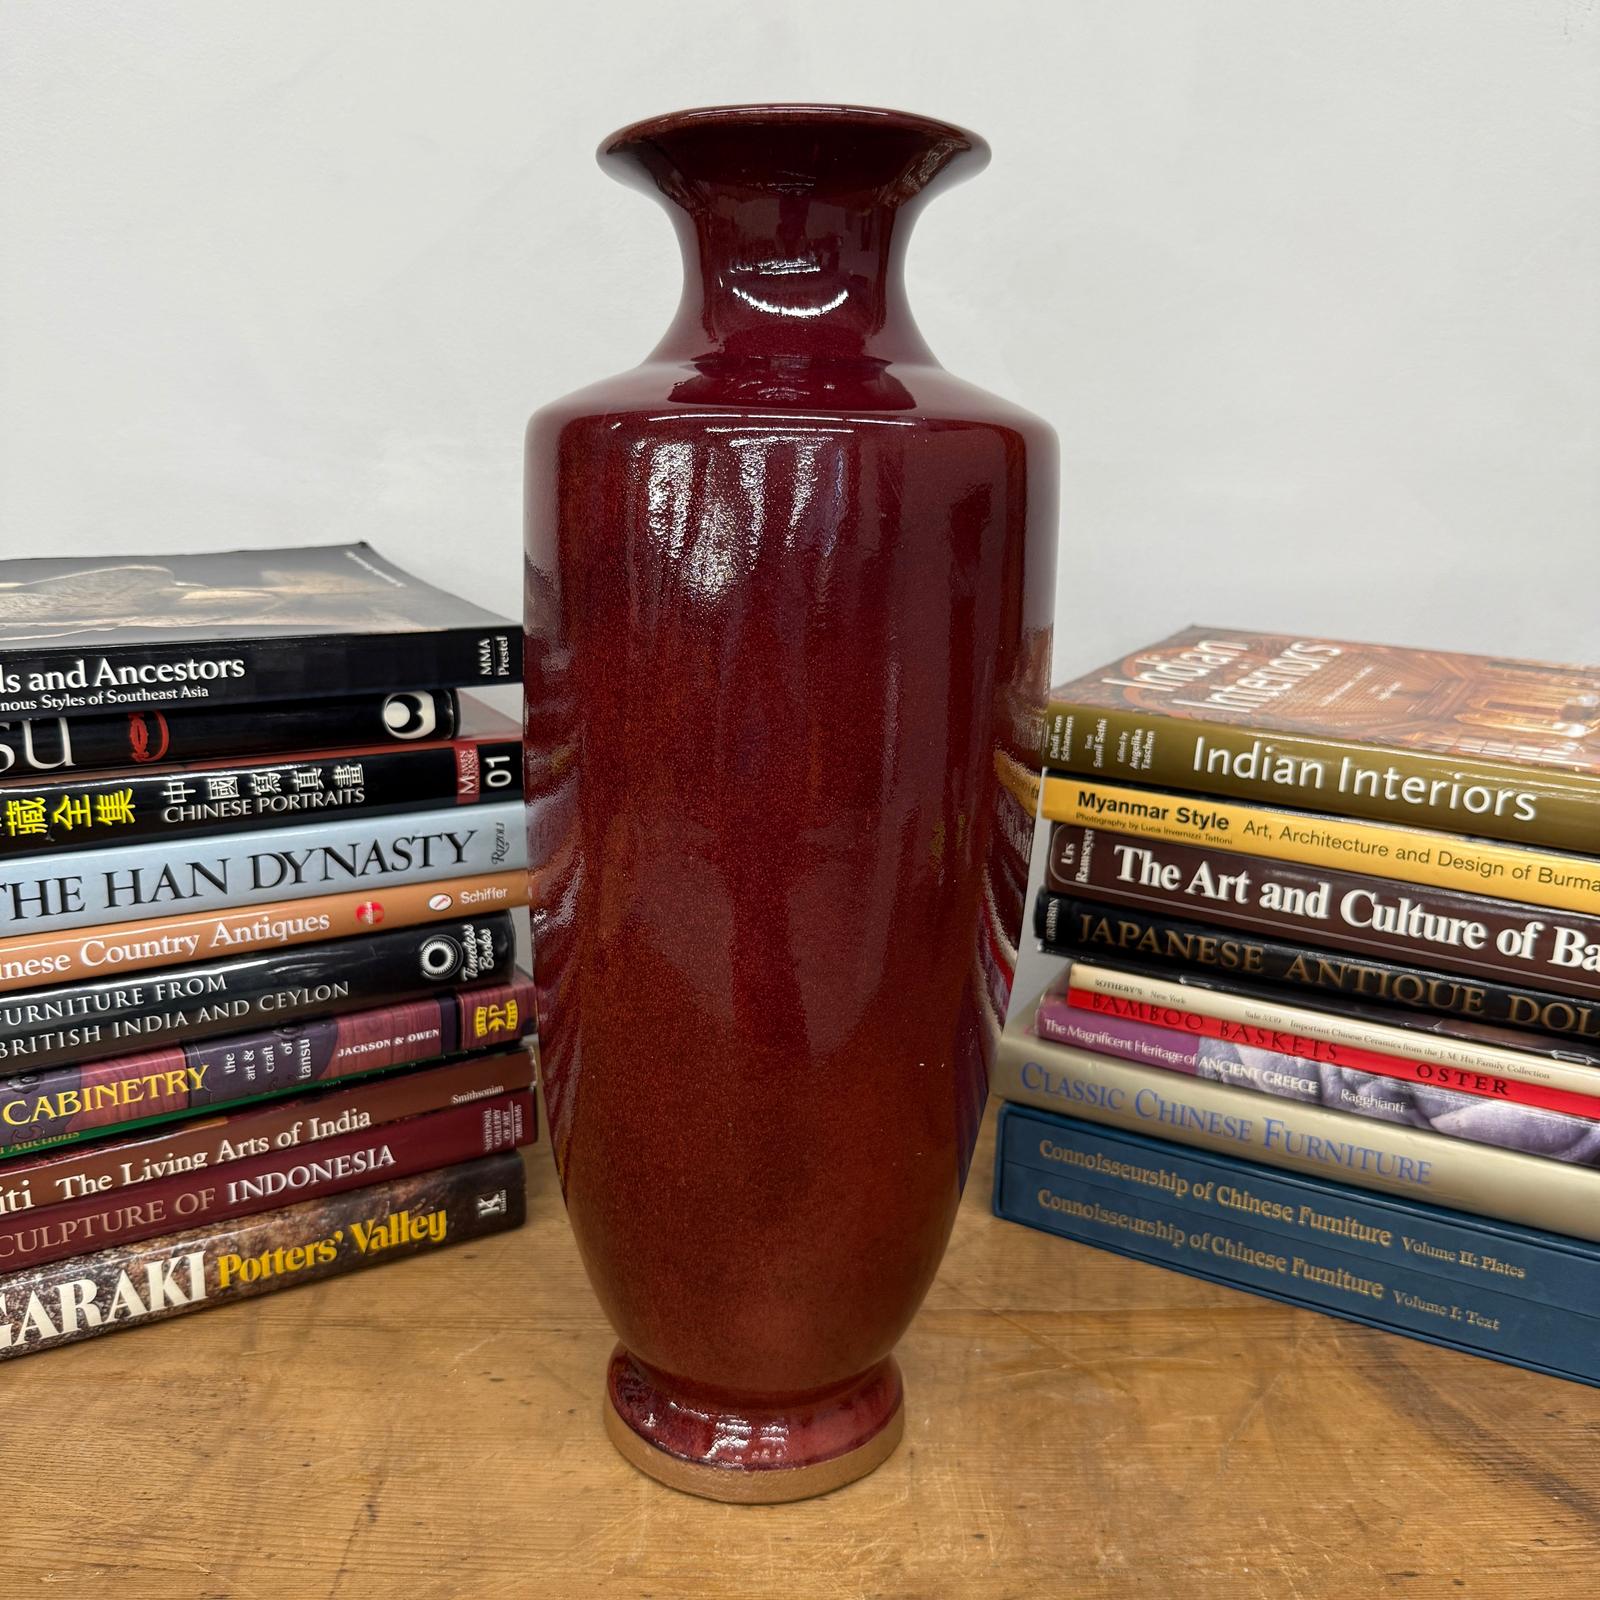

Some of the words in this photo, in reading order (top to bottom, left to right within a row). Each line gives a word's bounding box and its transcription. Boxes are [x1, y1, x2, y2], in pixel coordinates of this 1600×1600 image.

[29, 659, 88, 691] and
[93, 657, 246, 687] Ancestors
[478, 638, 492, 675] MMA
[496, 636, 510, 676] Prestel
[1102, 640, 1249, 691] Indian
[1172, 641, 1342, 712] Interiors
[42, 693, 86, 711] Styles
[88, 691, 104, 705] of
[104, 686, 178, 704] Southeast
[181, 685, 209, 698] Asia
[1095, 718, 1107, 743] Sethi
[1129, 728, 1143, 769] Angelika
[1141, 731, 1154, 769] Taschen
[485, 756, 512, 787] 01
[1093, 743, 1104, 768] Sunil
[1192, 736, 1324, 789] Indian
[1338, 756, 1537, 822] Interiors
[164, 799, 252, 823] CHINESE
[259, 787, 365, 813] PORTRAITS
[1076, 812, 1127, 829] Photography
[1128, 821, 1138, 832] by
[1141, 823, 1161, 834] Luca
[1061, 842, 1075, 865] Urs
[1075, 829, 1095, 883] Ramseyer
[1078, 791, 1169, 820] Myanmar
[1176, 807, 1230, 831] Style
[1243, 820, 1273, 841] Art,
[1279, 826, 1389, 857] Architecture
[1395, 845, 1430, 864] and
[1437, 850, 1504, 879] Design
[1511, 864, 1534, 881] of
[1536, 867, 1600, 893] Burma
[0, 876, 86, 921] HE
[102, 858, 231, 909] HAN
[249, 830, 478, 891] DYNASTY
[460, 887, 508, 904] Schiffer
[1114, 844, 1182, 890] The
[1184, 860, 1252, 904] Art
[1259, 881, 1331, 920] and
[1340, 888, 1489, 950] Culture
[1496, 921, 1545, 960] of
[1547, 925, 1600, 973] Ba
[80, 933, 200, 967] Country
[210, 913, 330, 948] Antiques
[461, 924, 478, 982] Timeless
[479, 928, 494, 970] Books
[1078, 913, 1266, 973] JAPANESE
[1284, 953, 1486, 1017] ANTIQUE
[0, 988, 144, 1026] URNITURE
[156, 974, 228, 1001] FROM
[111, 1009, 189, 1038] INDIA
[198, 999, 250, 1024] AND
[258, 981, 349, 1011] CEYLON
[337, 1039, 390, 1056] JACKSON
[394, 1036, 404, 1045] &
[407, 1029, 440, 1043] OWEN
[1092, 991, 1203, 1030] BAMBOO
[1220, 1019, 1337, 1061] BASKETS
[1151, 991, 1166, 1001] New
[1168, 993, 1186, 1004] York
[1245, 1010, 1261, 1021] Sale
[1290, 1020, 1329, 1036] Important
[1332, 1028, 1363, 1042] Chinese
[1364, 1036, 1401, 1049] Ceramics
[1403, 1042, 1423, 1054] from
[1424, 1046, 1438, 1056] the
[1460, 1054, 1475, 1065] Hu
[1476, 1058, 1504, 1073] Family
[1507, 1063, 1550, 1080] Collection
[224, 1053, 236, 1073] the
[244, 1050, 254, 1060] &
[263, 1045, 274, 1073] craft
[281, 1042, 292, 1054] of
[298, 1039, 311, 1079] tansu
[1044, 1018, 1066, 1035] The
[1066, 1024, 1133, 1051] Magnificent
[1134, 1036, 1183, 1064] Heritage
[1184, 1051, 1199, 1065] of
[1199, 1055, 1261, 1080] ANCIENT
[1262, 1070, 1319, 1094] GREECE
[1340, 1089, 1406, 1113] Ragghianti
[246, 1064, 255, 1080] art
[1416, 1063, 1510, 1096] OSTER
[3, 1065, 209, 1125] CABINETRY
[452, 1085, 504, 1104] Smithsonian
[1021, 1061, 1125, 1111] CLASSIC
[1134, 1088, 1253, 1141] CHINESE
[1263, 1117, 1432, 1185] FURNITURE
[56, 1174, 113, 1200] The
[120, 1151, 208, 1187] Living
[217, 1138, 269, 1164] Arts
[278, 1121, 302, 1148] of
[308, 1108, 372, 1136] India
[174, 1188, 215, 1216] OF
[226, 1144, 396, 1204] INDONESIA
[1039, 1139, 1188, 1197] Connoisseurship
[1192, 1181, 1214, 1200] of
[1216, 1185, 1293, 1223] Chinese
[1298, 1205, 1392, 1247] Furniture
[1402, 1236, 1455, 1261] Volume
[1459, 1250, 1477, 1268] II:
[1480, 1255, 1526, 1279] Plates
[217, 1230, 343, 1289] Potters'
[350, 1209, 447, 1255] Valley
[1037, 1189, 1185, 1247] Connoisseurship
[1189, 1232, 1211, 1250] of
[1211, 1236, 1287, 1274] Chinese
[1291, 1256, 1384, 1299] Furniture
[1393, 1290, 1446, 1316] Volume
[1450, 1306, 1462, 1320] I:
[1465, 1310, 1501, 1331] Text
